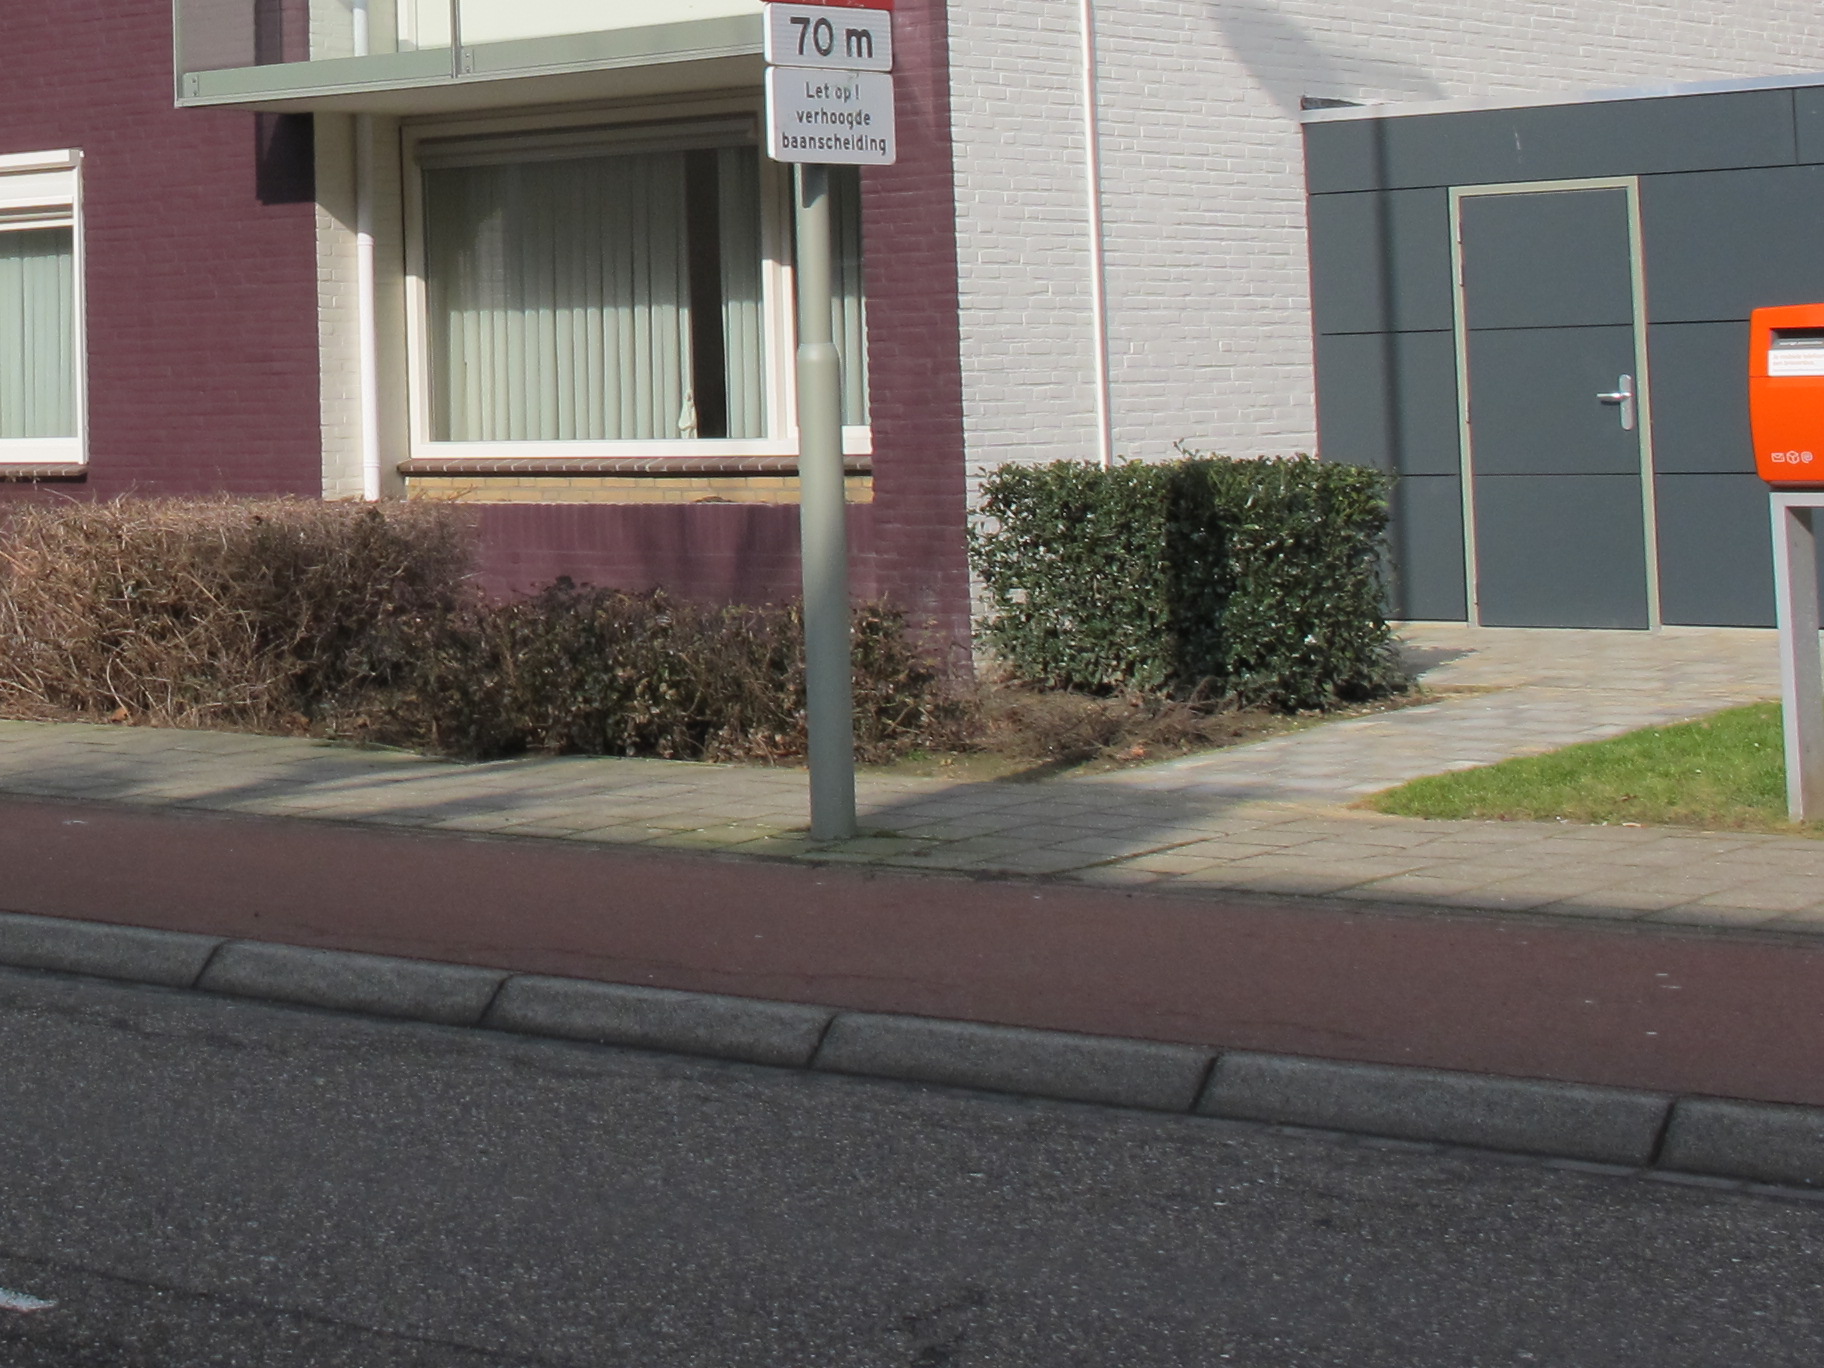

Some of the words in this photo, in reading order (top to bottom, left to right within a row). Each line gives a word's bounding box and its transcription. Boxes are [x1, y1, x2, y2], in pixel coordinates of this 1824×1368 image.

[789, 16, 833, 57] 70
[845, 28, 873, 59] m
[805, 81, 829, 99] Let
[796, 107, 871, 130] verhoogde
[781, 132, 887, 156] baanscheiding
